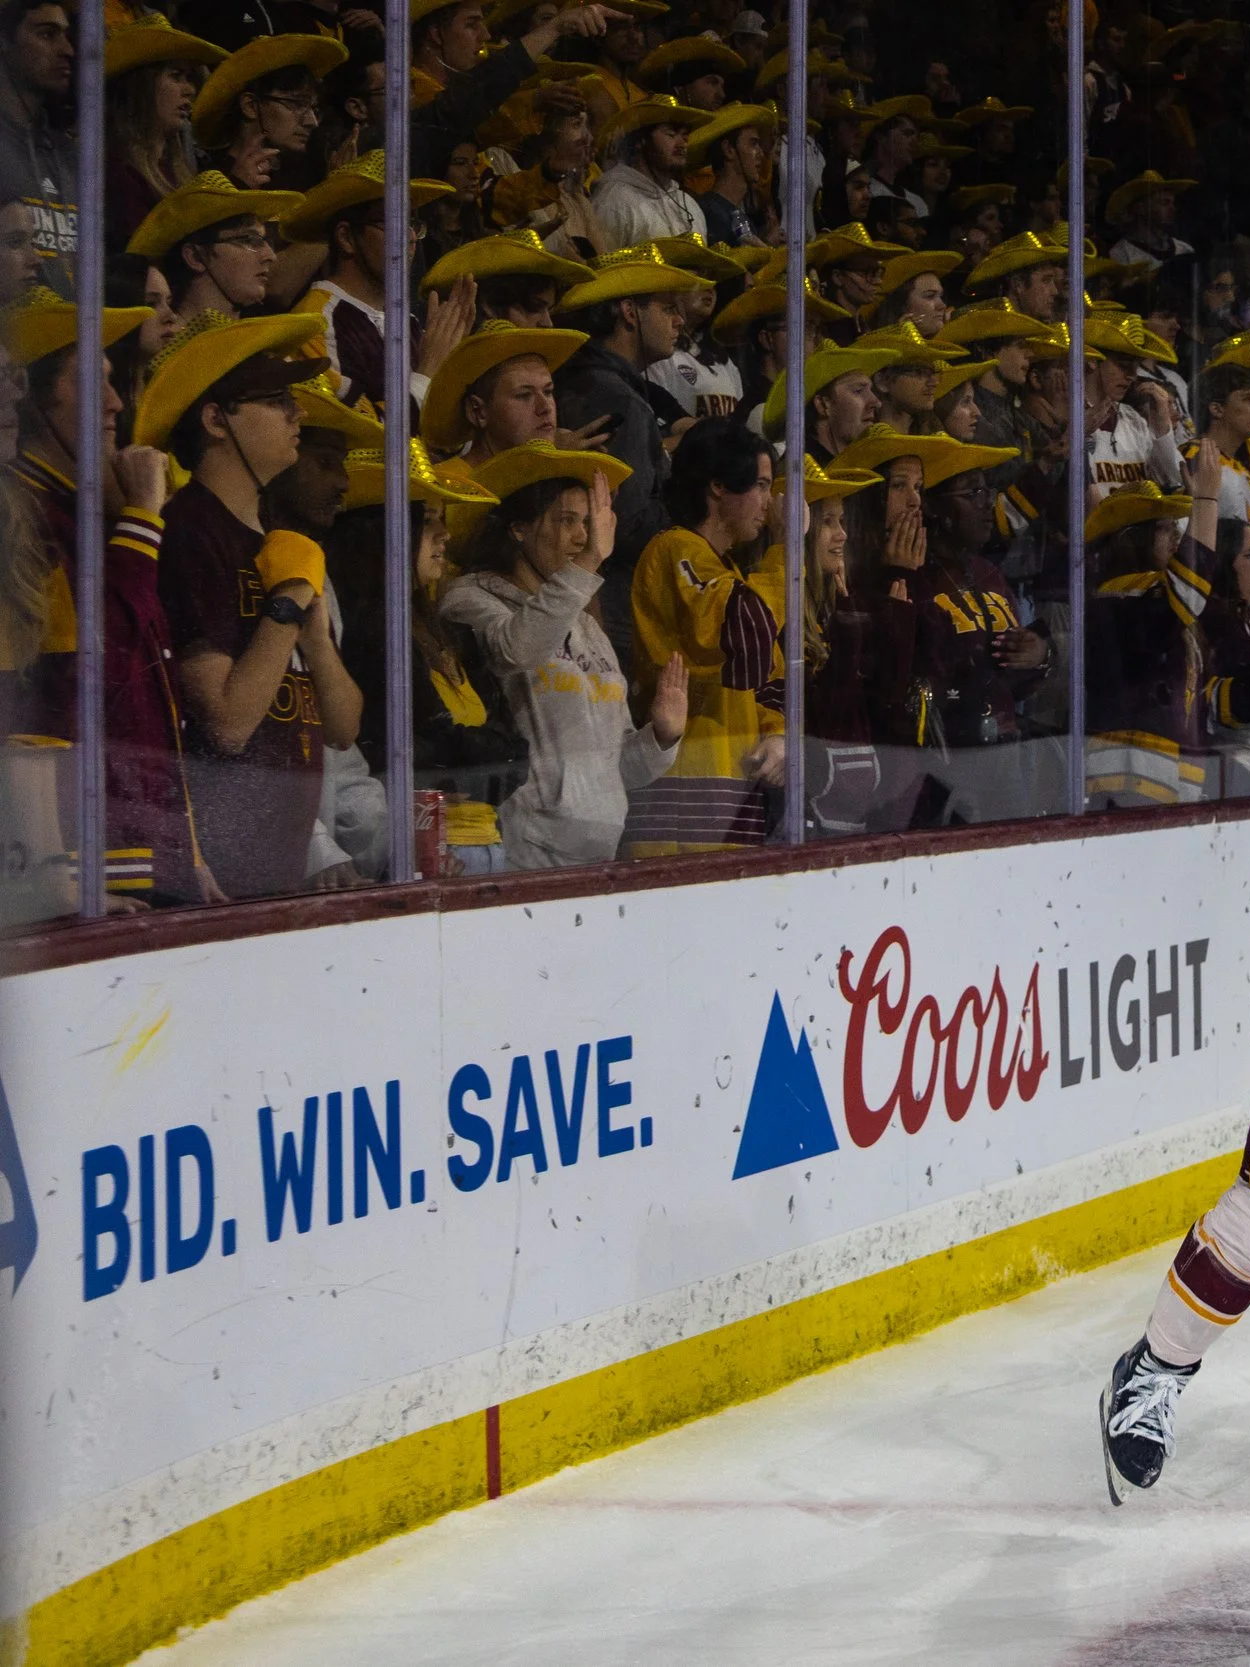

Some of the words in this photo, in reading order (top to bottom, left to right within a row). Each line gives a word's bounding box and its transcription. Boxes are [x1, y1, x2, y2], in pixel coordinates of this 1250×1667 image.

[838, 924, 1049, 1149] Coors
[1058, 937, 1210, 1089] LIGHT
[82, 1123, 237, 1303] BID.
[257, 1079, 426, 1243] WIN.
[446, 1034, 653, 1193] SAVE.
